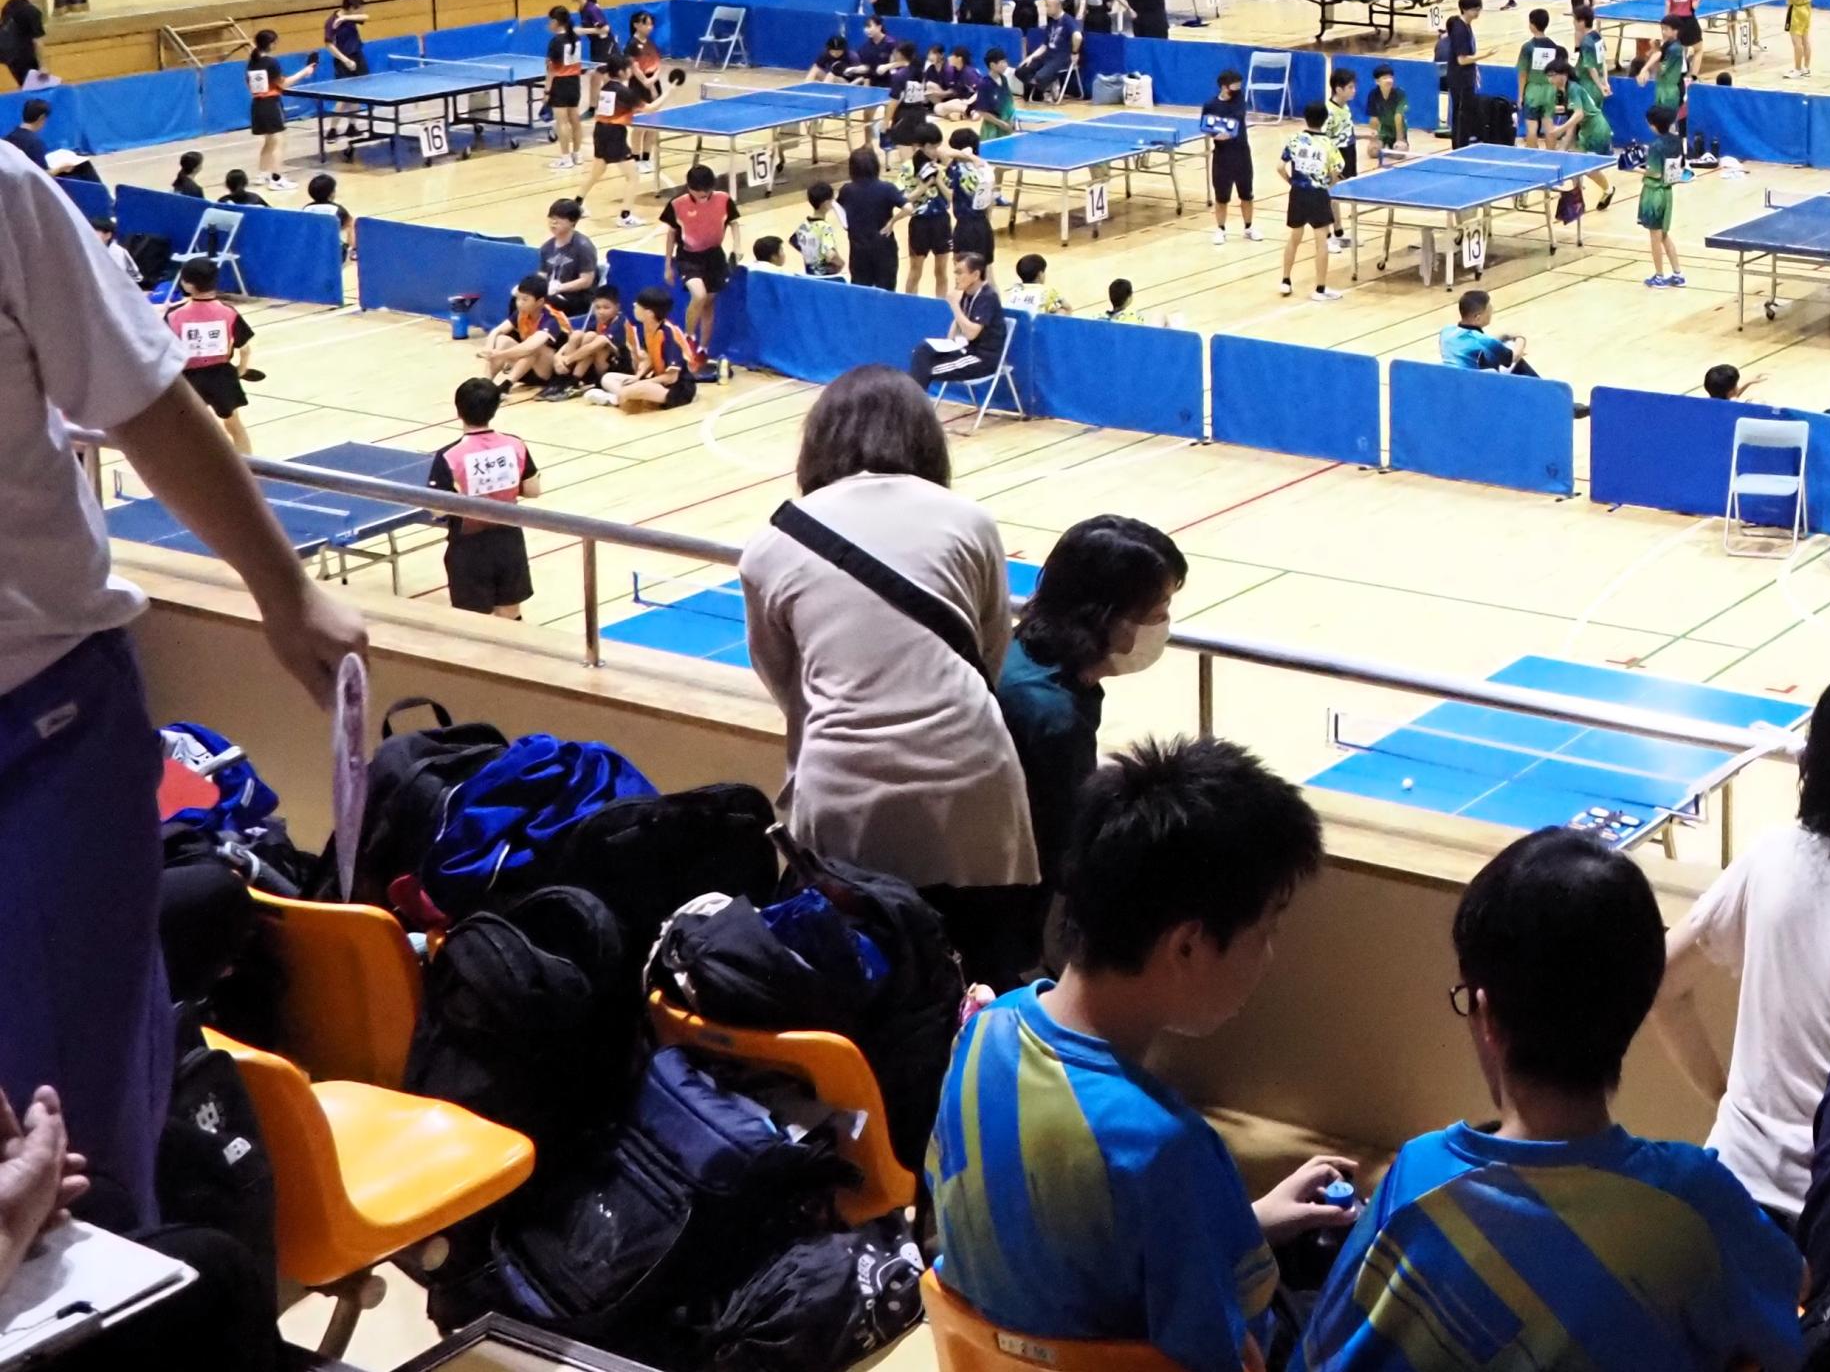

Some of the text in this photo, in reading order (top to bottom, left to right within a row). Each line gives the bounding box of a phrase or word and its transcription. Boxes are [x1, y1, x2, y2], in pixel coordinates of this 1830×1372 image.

[423, 124, 444, 151] 16
[750, 152, 768, 180] 15
[1089, 185, 1105, 217] 14
[1467, 228, 1482, 261] 13
